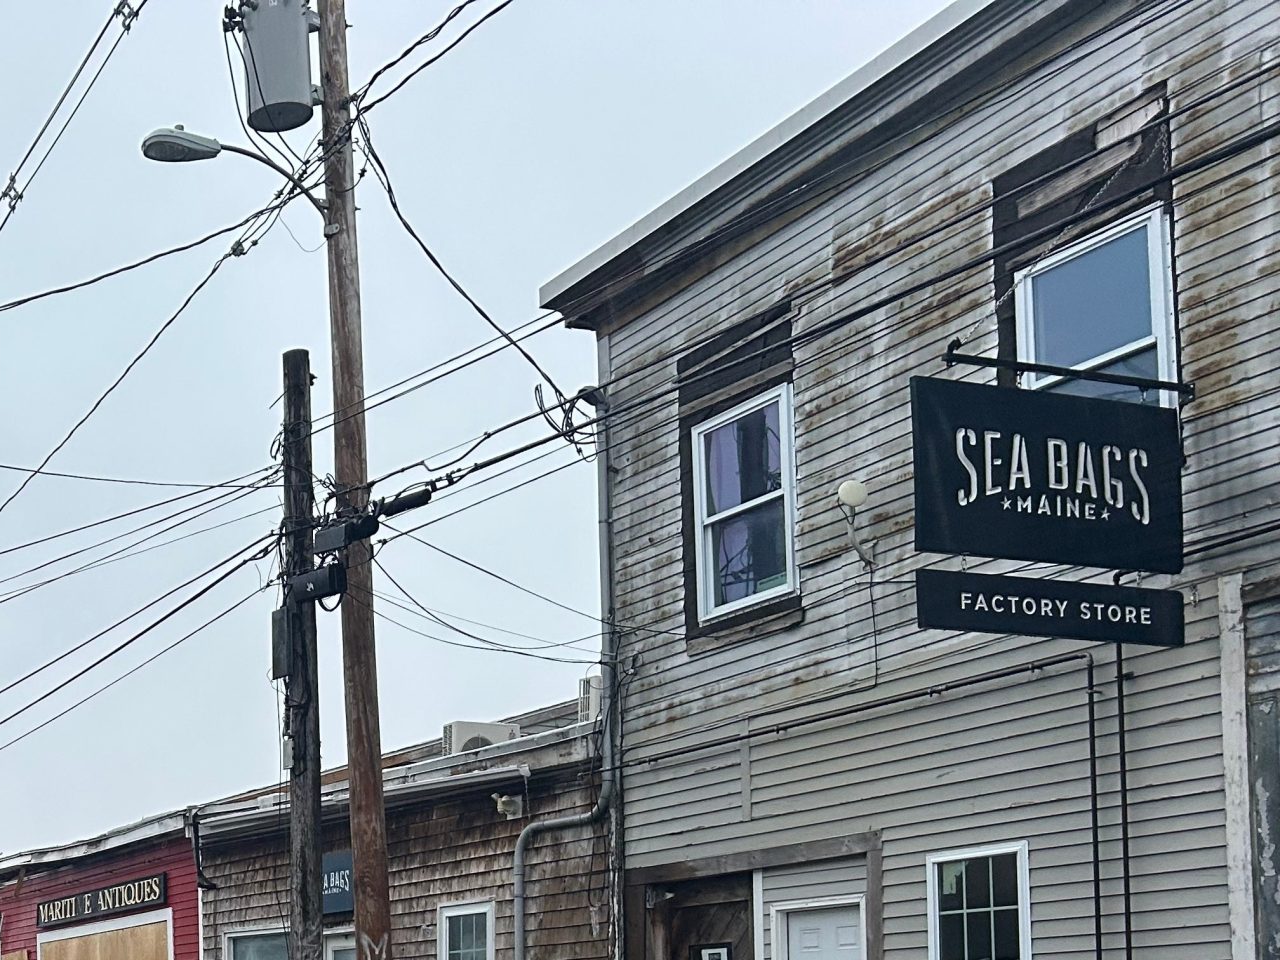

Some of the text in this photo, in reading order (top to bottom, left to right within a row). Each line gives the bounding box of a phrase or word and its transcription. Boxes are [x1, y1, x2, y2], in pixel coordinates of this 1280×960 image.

[955, 427, 1151, 525] SEA BAGS
[1017, 495, 1096, 520] MAINE
[960, 592, 1152, 625] FACTORY STORE
[330, 869, 350, 892] BAGS
[39, 877, 160, 923] MARITIE ANTIQUES
